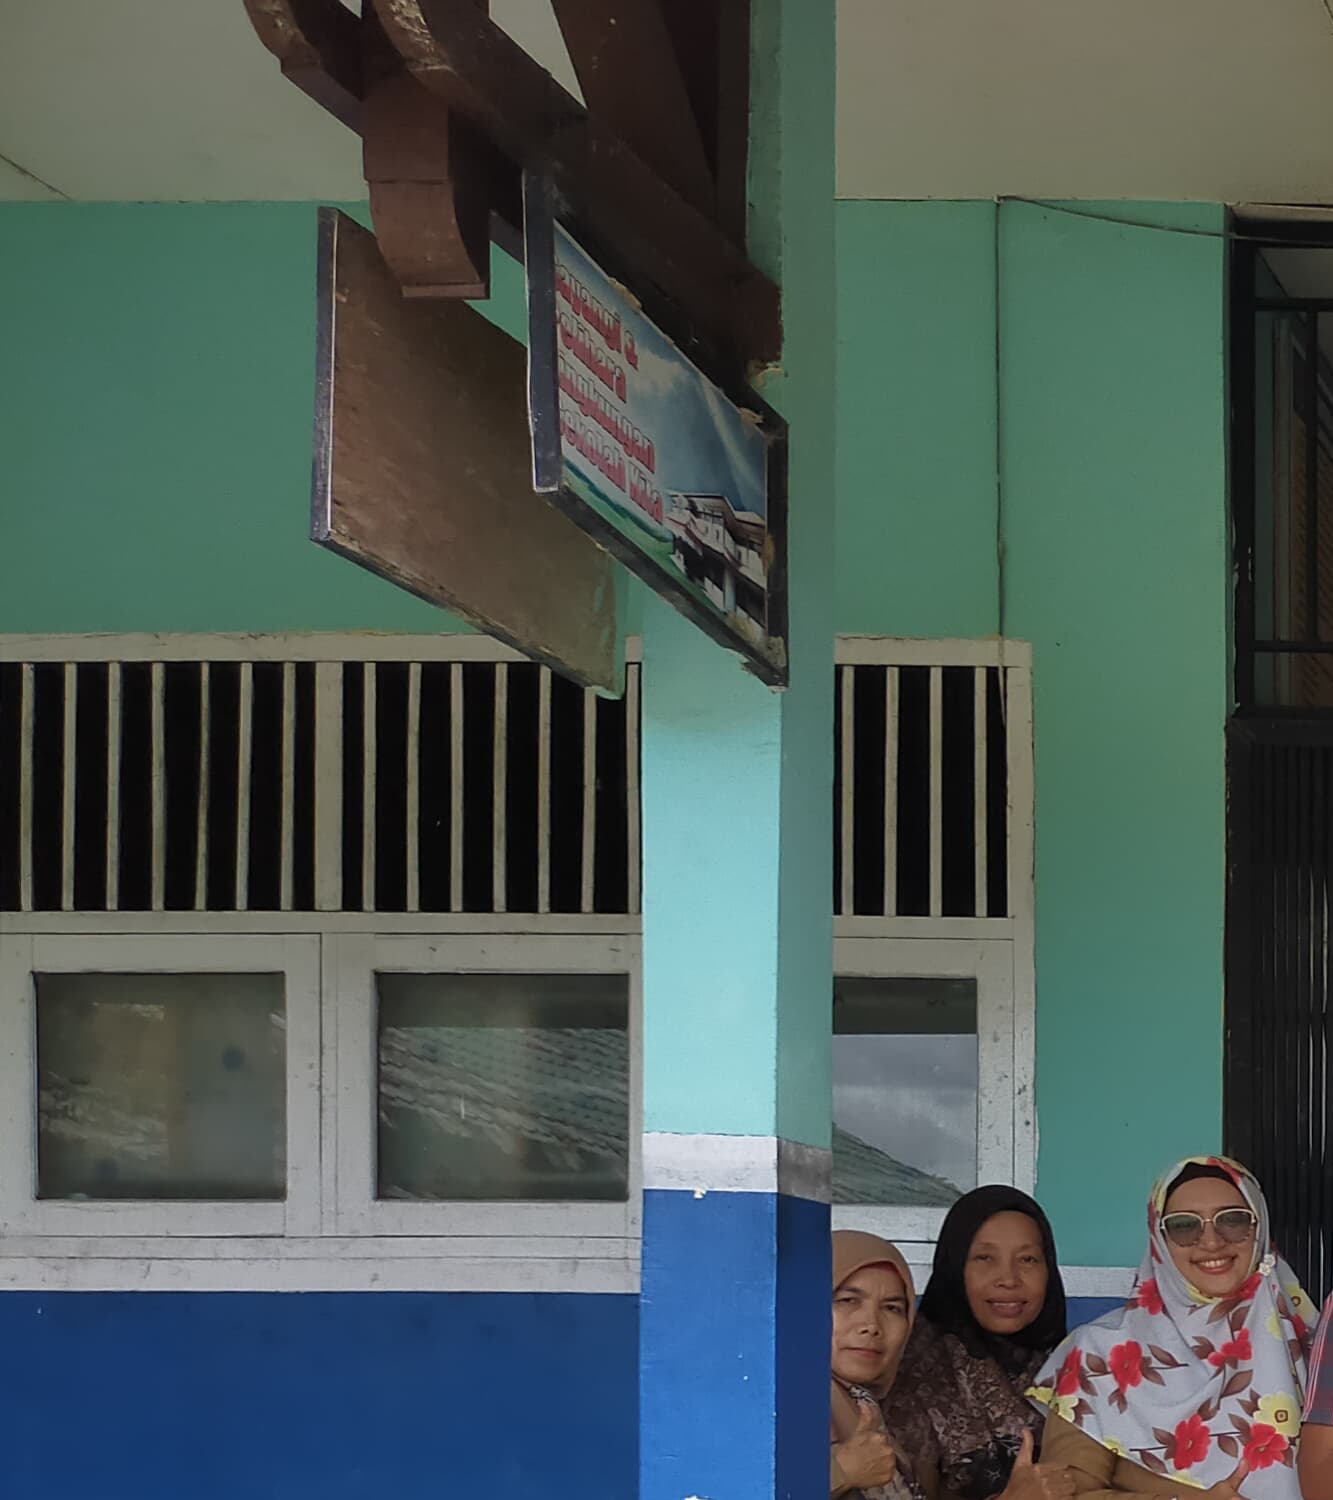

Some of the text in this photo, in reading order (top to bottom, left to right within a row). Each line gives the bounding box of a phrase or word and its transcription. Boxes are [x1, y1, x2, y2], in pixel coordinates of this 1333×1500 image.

[554, 259, 638, 371] ayangi &
[556, 306, 626, 403] elihara
[559, 350, 655, 474] ingkungan
[630, 460, 664, 525] Kita
